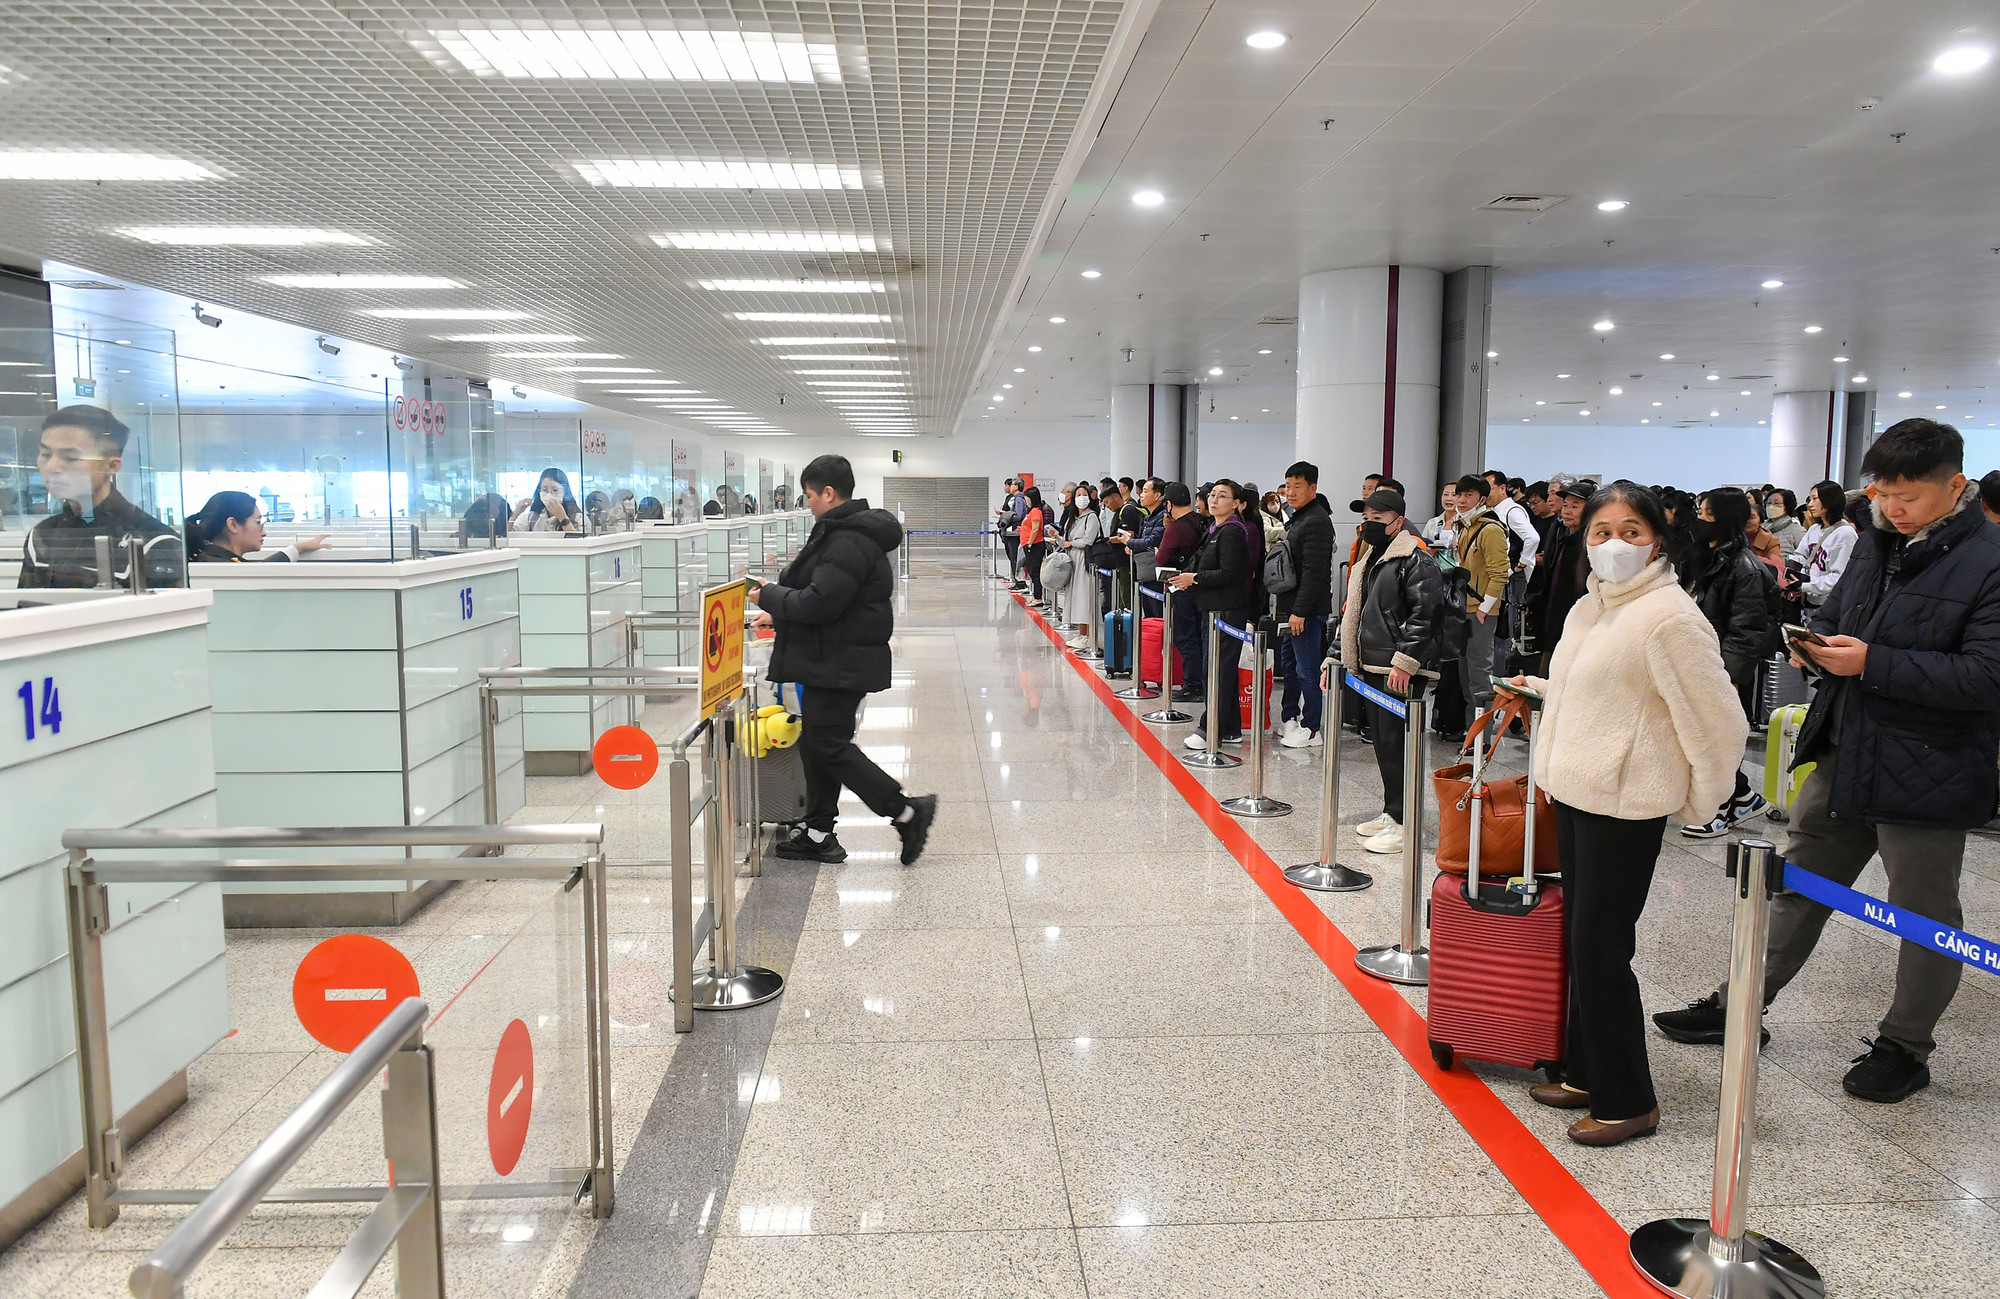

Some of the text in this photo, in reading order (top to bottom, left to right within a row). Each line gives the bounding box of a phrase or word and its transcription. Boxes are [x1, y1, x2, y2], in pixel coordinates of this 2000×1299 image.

[460, 587, 473, 620] 15
[18, 676, 62, 741] 14
[1864, 902, 1896, 928] N.I.A
[1934, 931, 1980, 961] CẢNG
